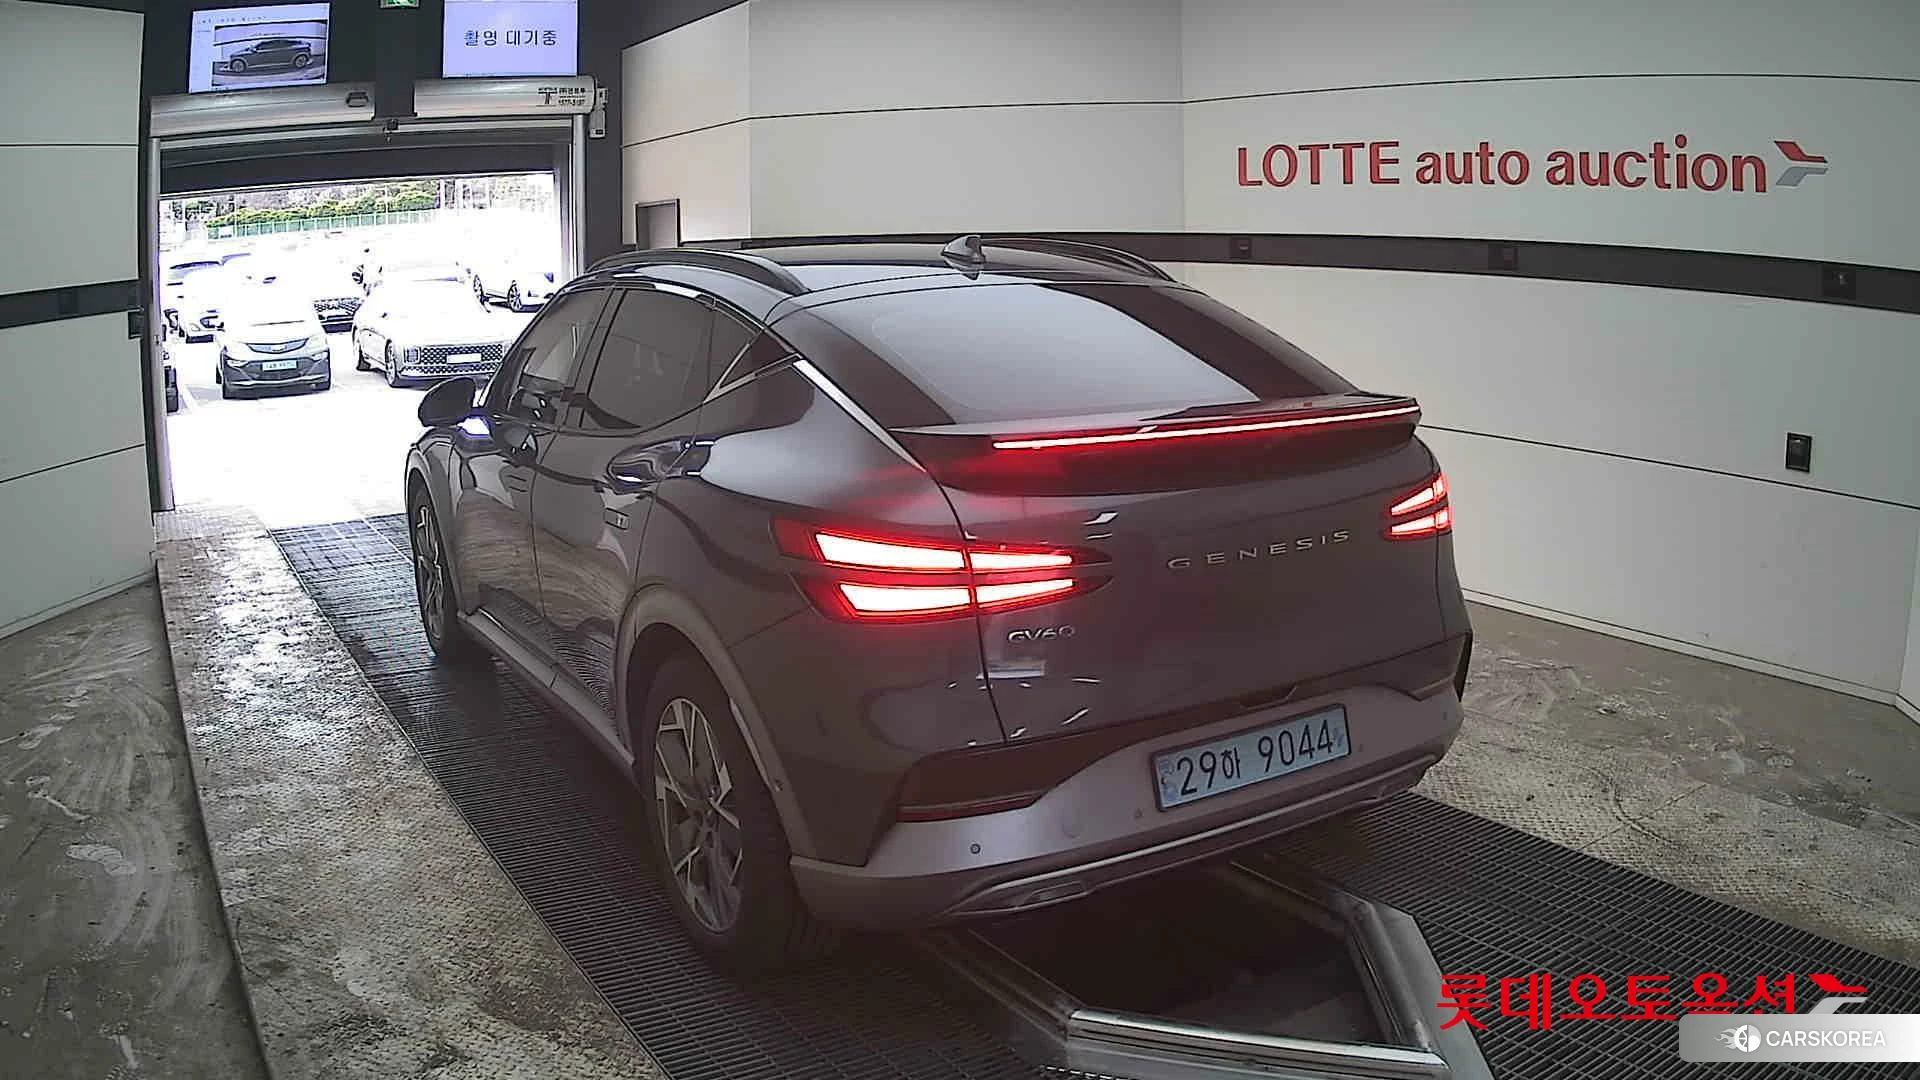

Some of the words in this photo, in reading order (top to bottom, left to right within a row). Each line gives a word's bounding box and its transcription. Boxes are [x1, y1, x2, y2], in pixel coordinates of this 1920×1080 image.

[464, 30, 497, 46] 촬영
[506, 30, 557, 46] 대기중
[1237, 141, 1400, 187] LOTTE
[1415, 142, 1530, 186] auto
[1545, 135, 1767, 193] auction
[1167, 530, 1350, 569] GENESIS
[1007, 625, 1075, 642] GV60
[1177, 747, 1240, 796] 29하
[1258, 719, 1334, 772] 9044
